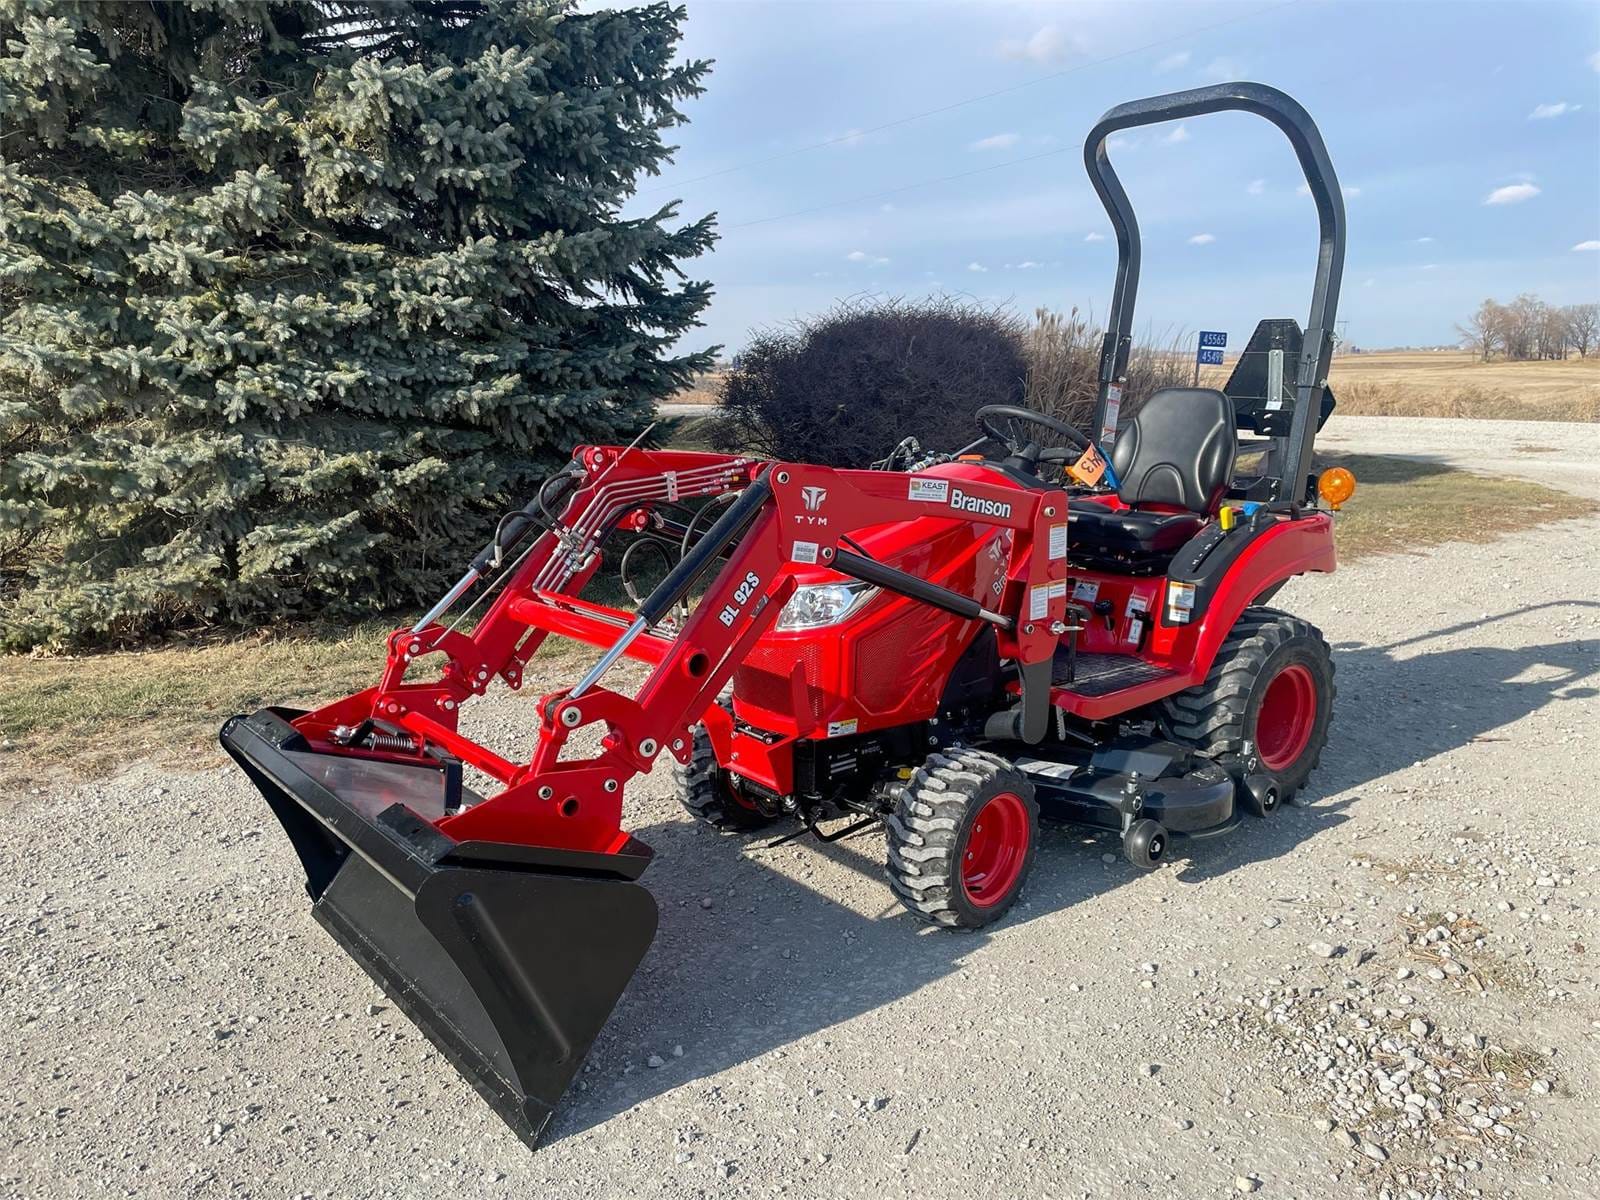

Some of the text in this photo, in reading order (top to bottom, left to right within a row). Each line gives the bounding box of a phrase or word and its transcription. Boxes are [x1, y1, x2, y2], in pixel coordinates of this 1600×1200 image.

[1203, 333, 1226, 345] 45565
[922, 481, 947, 490] KEAST
[950, 488, 1011, 518] Branson
[794, 515, 827, 526] TYM
[719, 571, 760, 628] BL 92S
